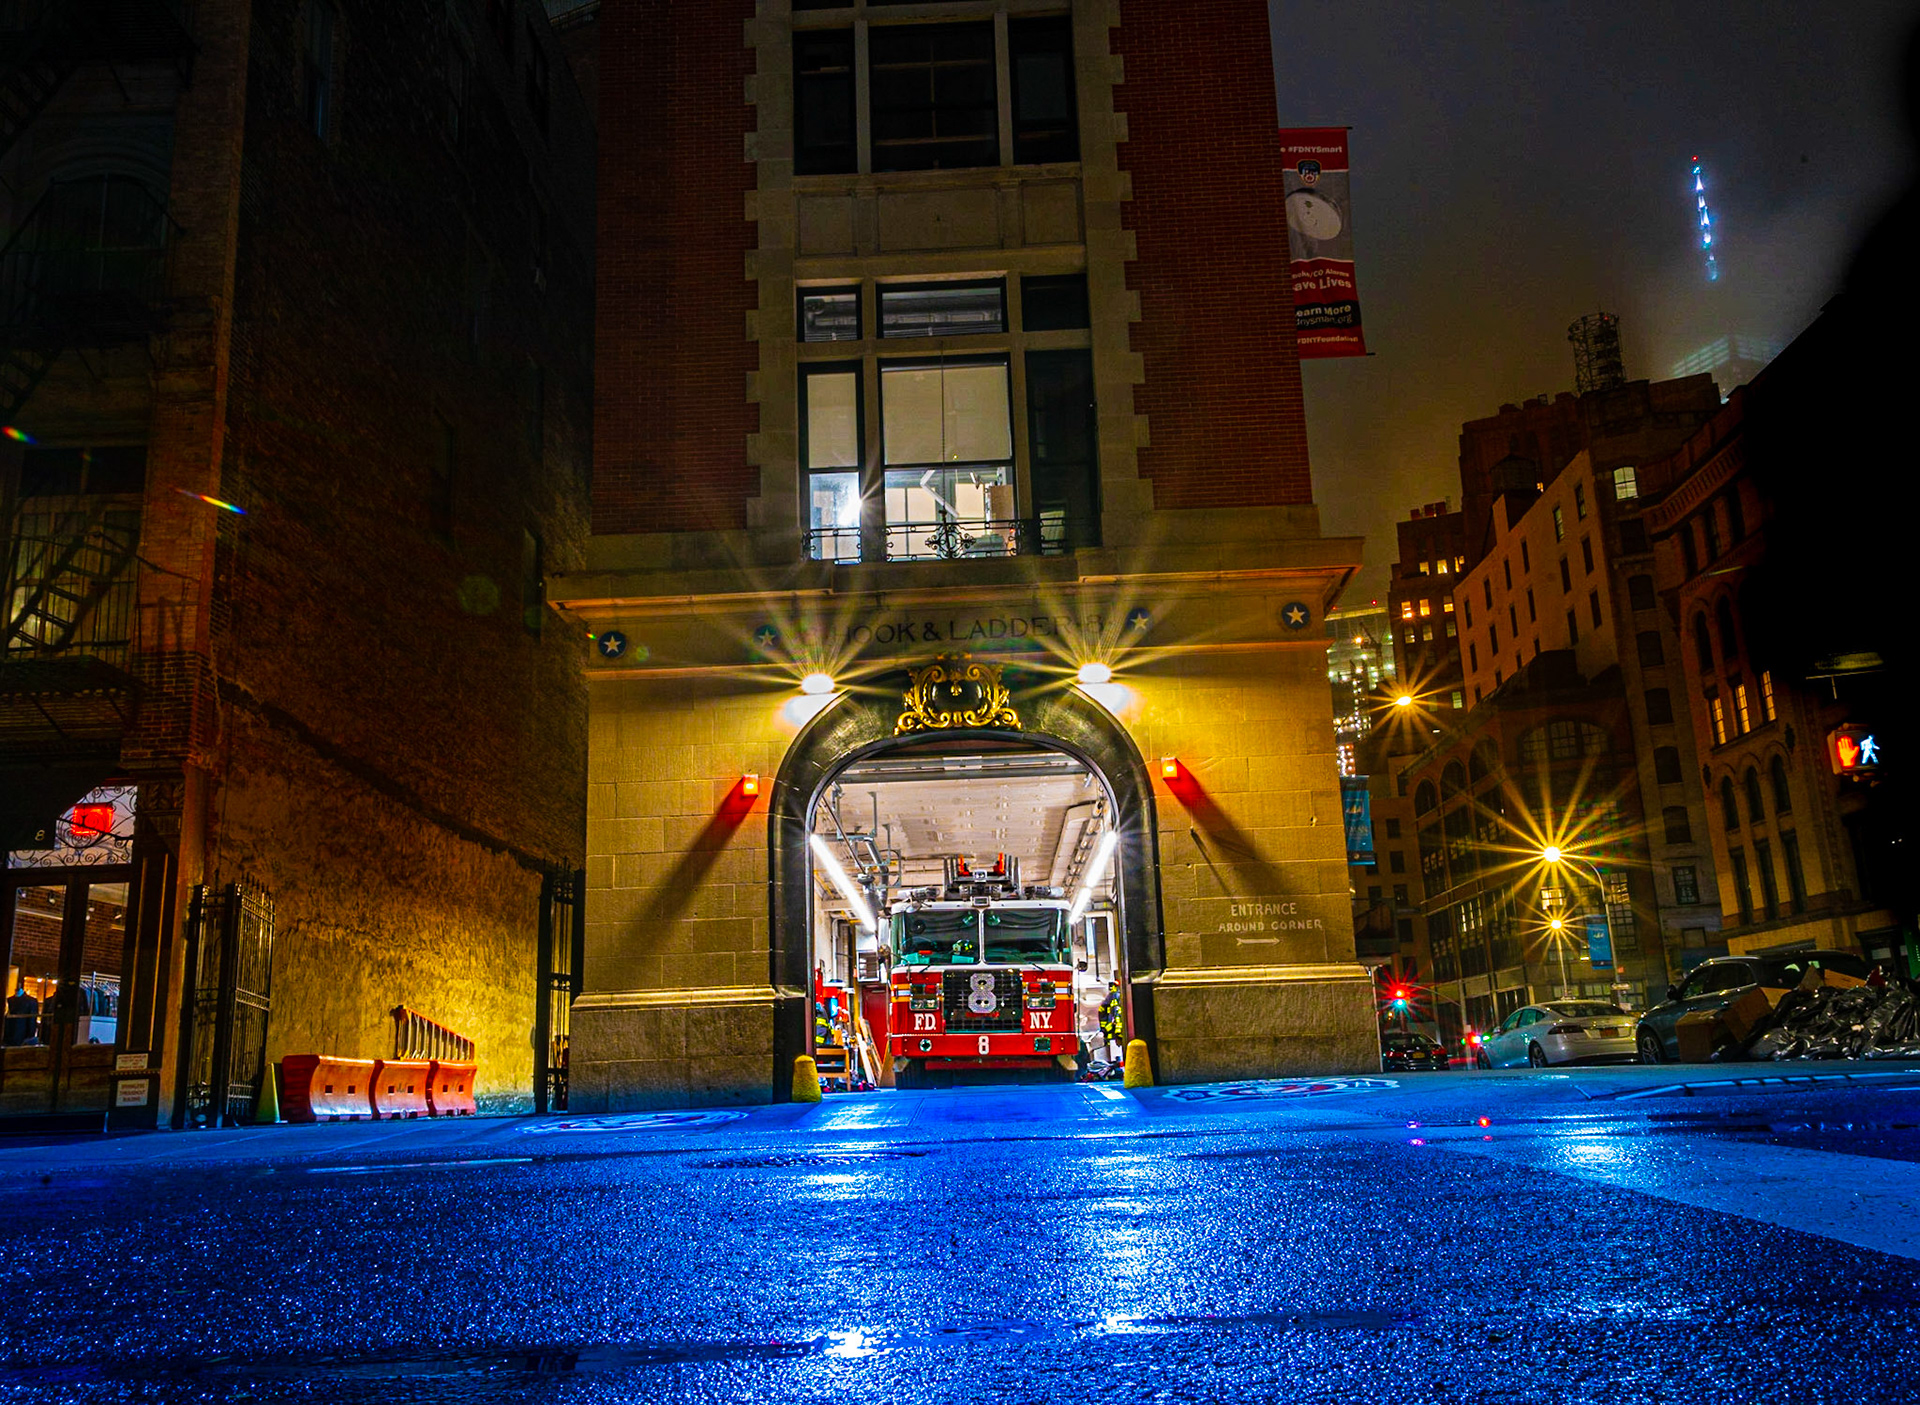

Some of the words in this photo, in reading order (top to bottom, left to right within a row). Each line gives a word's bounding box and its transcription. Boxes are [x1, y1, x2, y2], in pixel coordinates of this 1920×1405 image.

[1288, 145, 1342, 153] #FDNYSmart
[1292, 280, 1317, 292] ave
[1319, 276, 1352, 290] Lives
[1323, 304, 1351, 316] More
[922, 621, 942, 642] &
[948, 614, 1072, 642] LADDER
[34, 829, 46, 842] 8
[1230, 902, 1298, 917] ENTRANCE
[1218, 921, 1265, 933] AROUND
[1270, 918, 1323, 931] CORNER
[967, 972, 997, 1014] 8
[978, 1035, 990, 1056] 8
